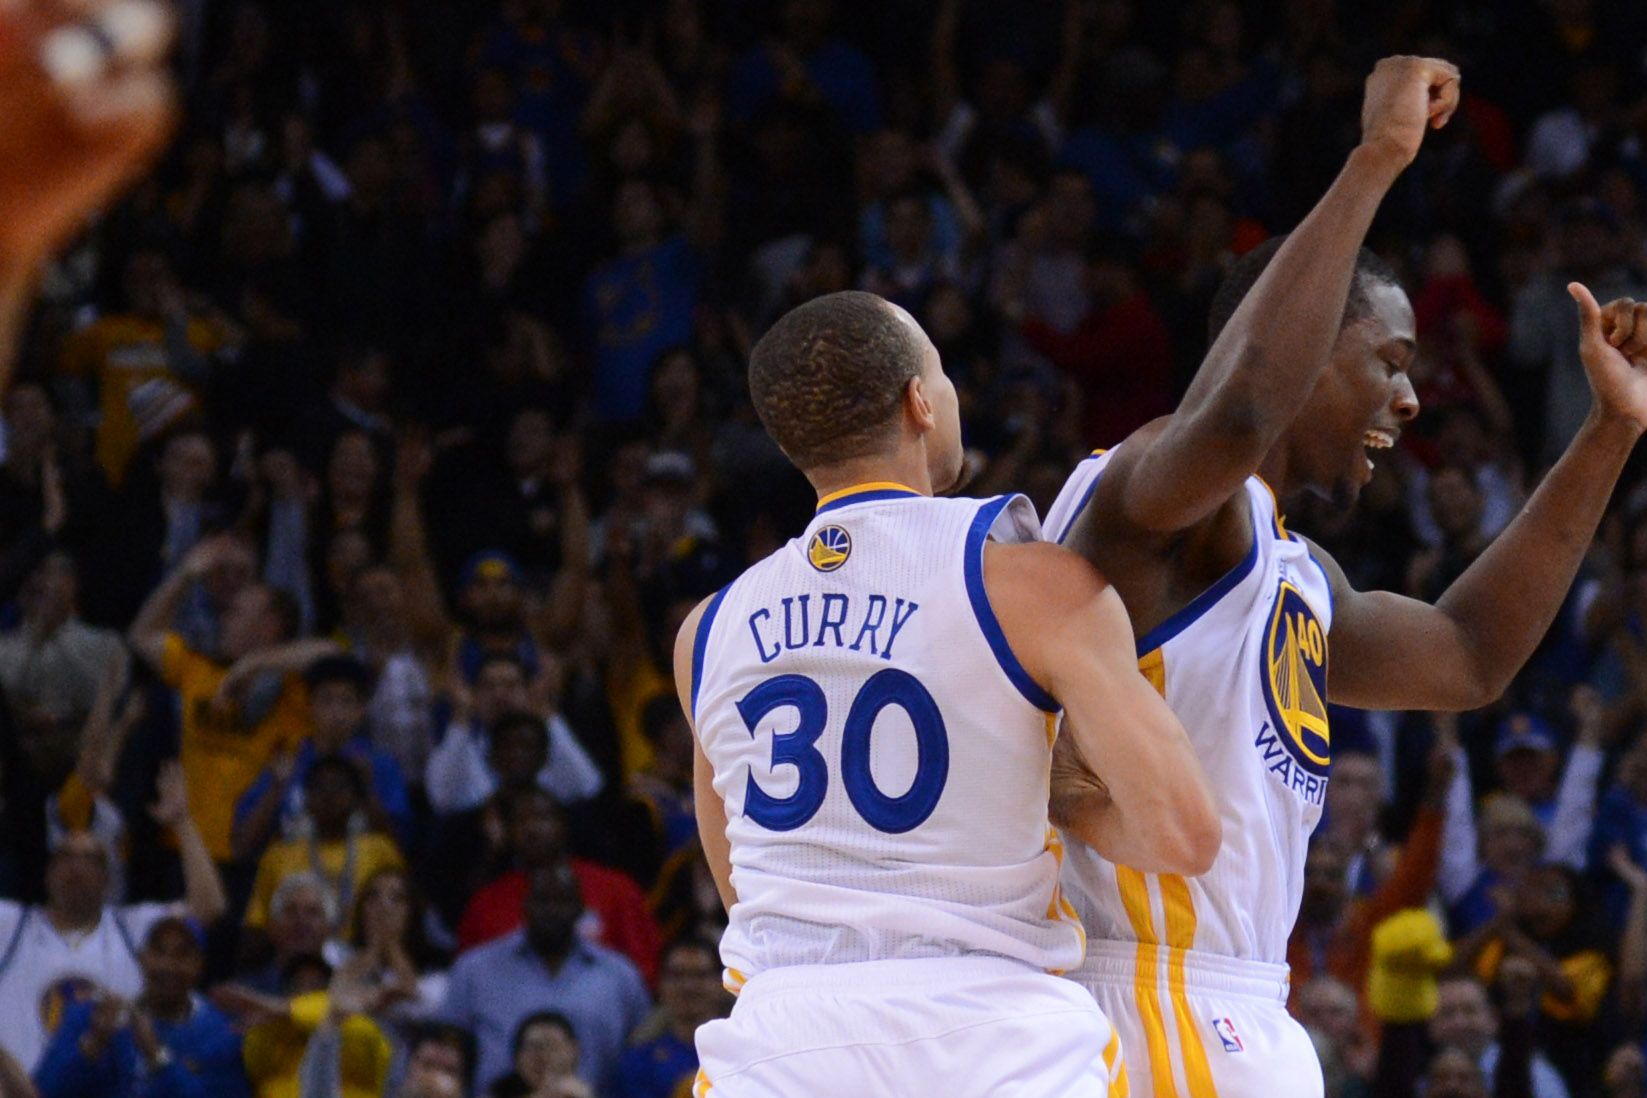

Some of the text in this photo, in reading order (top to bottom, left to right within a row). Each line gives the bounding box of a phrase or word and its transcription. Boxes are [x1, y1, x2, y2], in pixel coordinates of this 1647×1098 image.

[748, 592, 919, 663] CURRY
[1297, 611, 1323, 667] 40
[735, 668, 950, 835] 30
